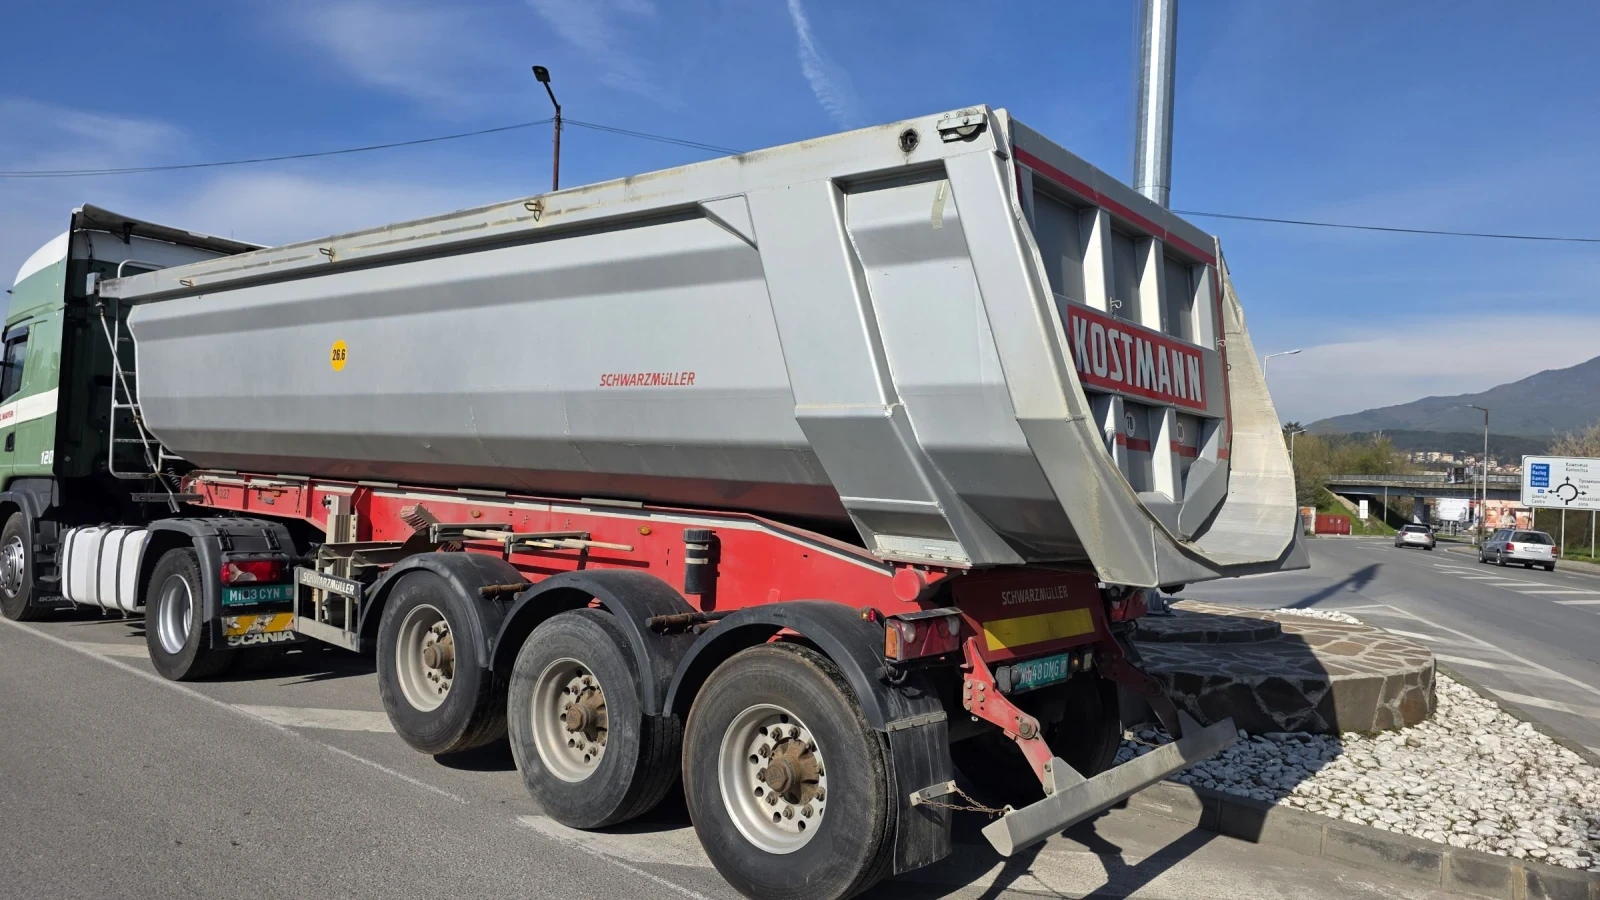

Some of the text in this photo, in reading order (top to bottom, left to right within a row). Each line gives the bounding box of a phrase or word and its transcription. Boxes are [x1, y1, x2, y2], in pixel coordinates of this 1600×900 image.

[332, 348, 346, 361] 26,6
[1072, 315, 1202, 402] KOSTMANN
[599, 372, 695, 387] SCHWARZMÜLLER
[302, 572, 355, 595] SCHWARZMÜLLER
[1002, 586, 1068, 605] SCHWARZMÜLLER
[228, 631, 296, 646] SCANIA
